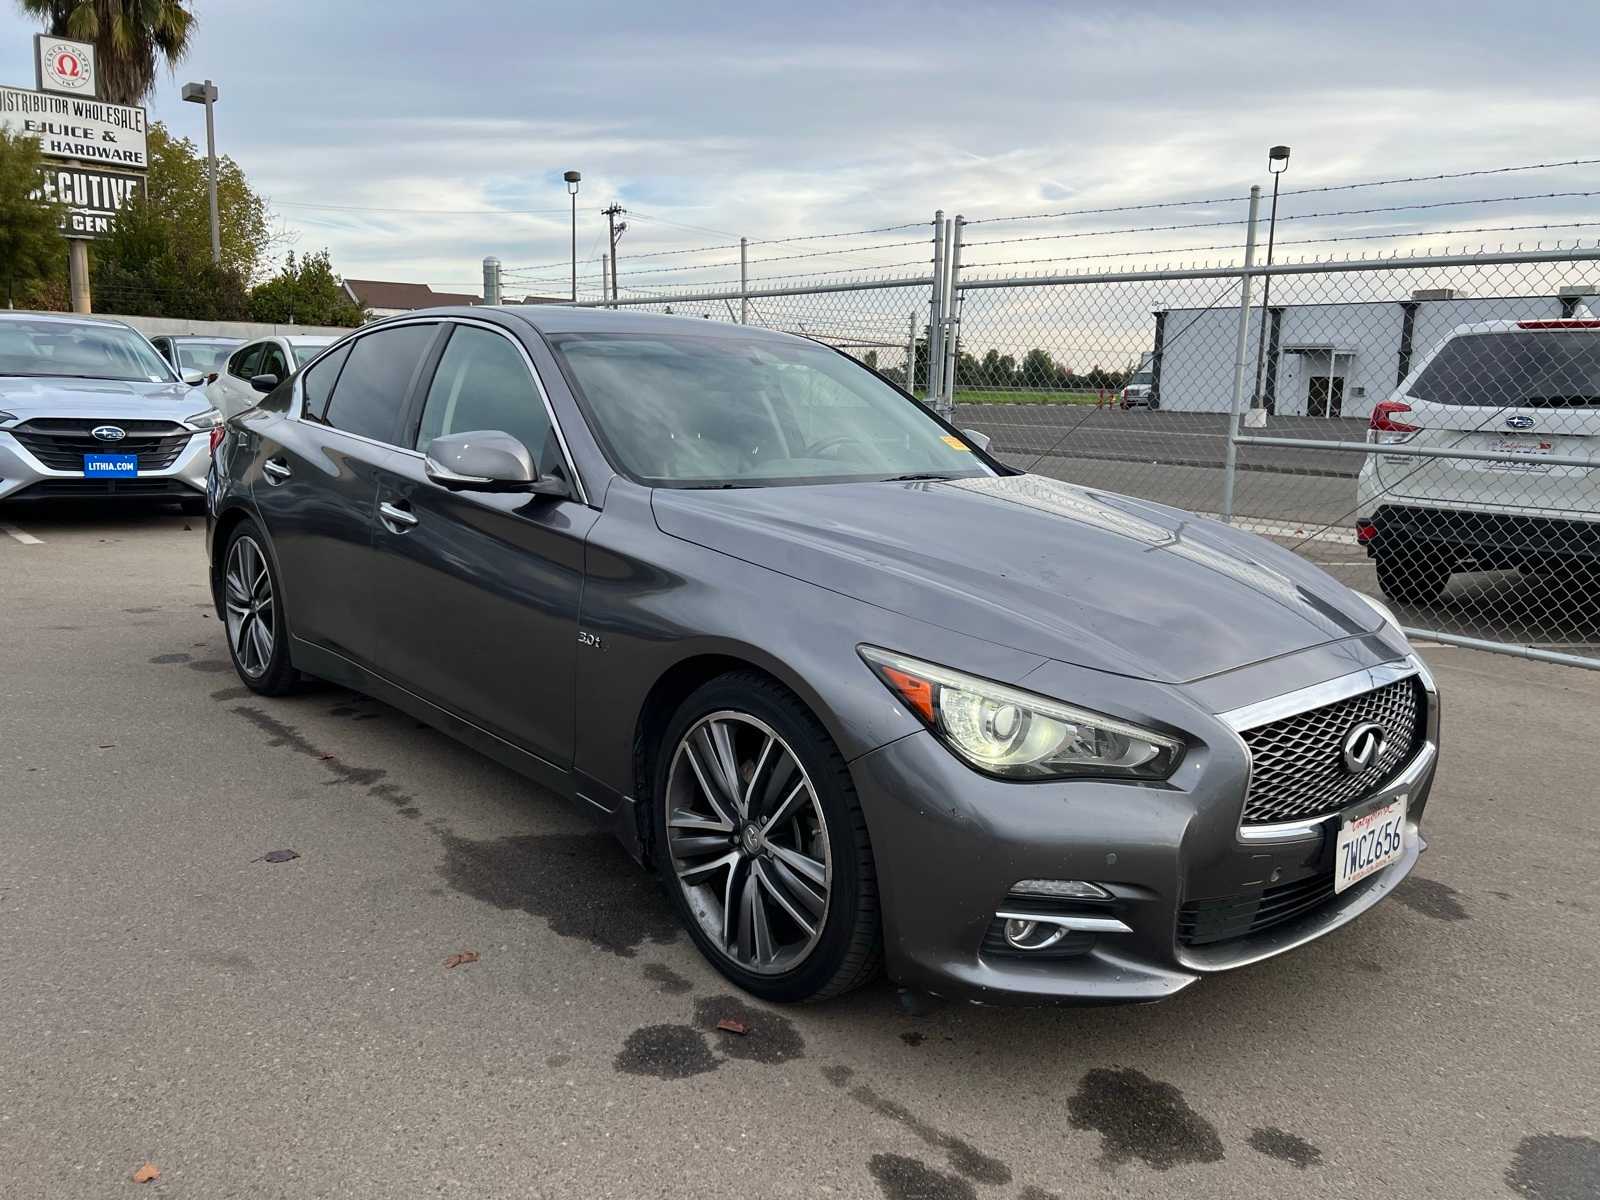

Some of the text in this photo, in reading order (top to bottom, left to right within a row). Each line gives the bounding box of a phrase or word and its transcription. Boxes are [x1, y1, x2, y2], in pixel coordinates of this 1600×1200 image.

[73, 101, 142, 133] WHOLESALE
[102, 130, 118, 143] &
[51, 140, 143, 163] HARDWARE
[88, 462, 134, 471] LITHIA.COM
[1342, 815, 1402, 879] 7WCZ656
